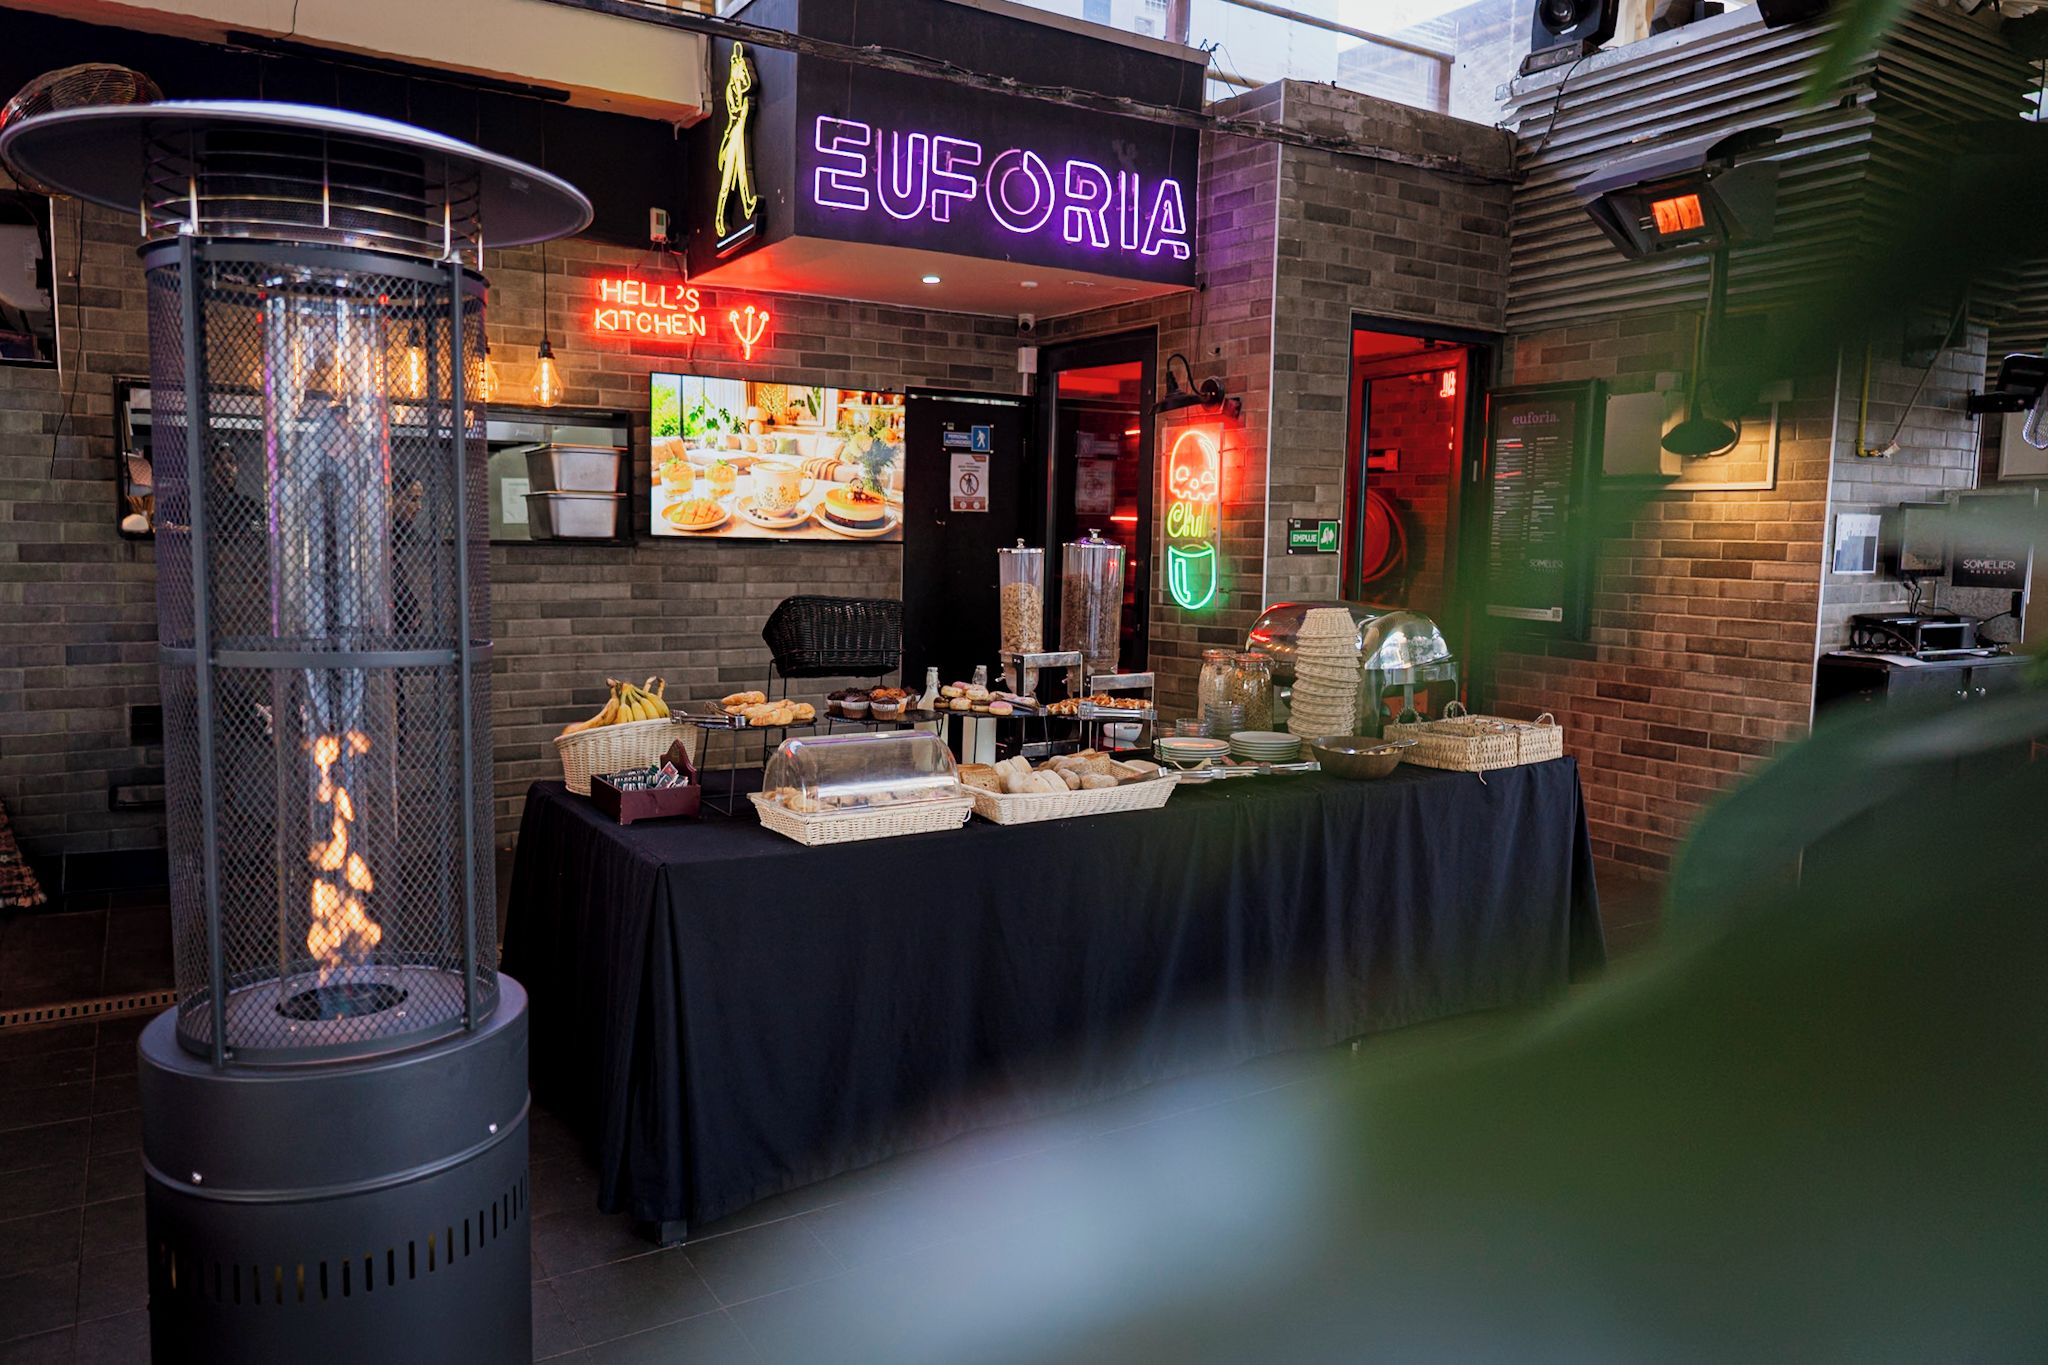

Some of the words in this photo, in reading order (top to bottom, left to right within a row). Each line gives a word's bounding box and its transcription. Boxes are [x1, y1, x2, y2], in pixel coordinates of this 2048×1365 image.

[813, 114, 1191, 261] EUFORIA
[600, 278, 700, 313] HELL'S
[594, 308, 707, 337] KITCHEN
[1292, 533, 1318, 543] EMPUJE
[1963, 559, 2016, 569] SOMELIER
